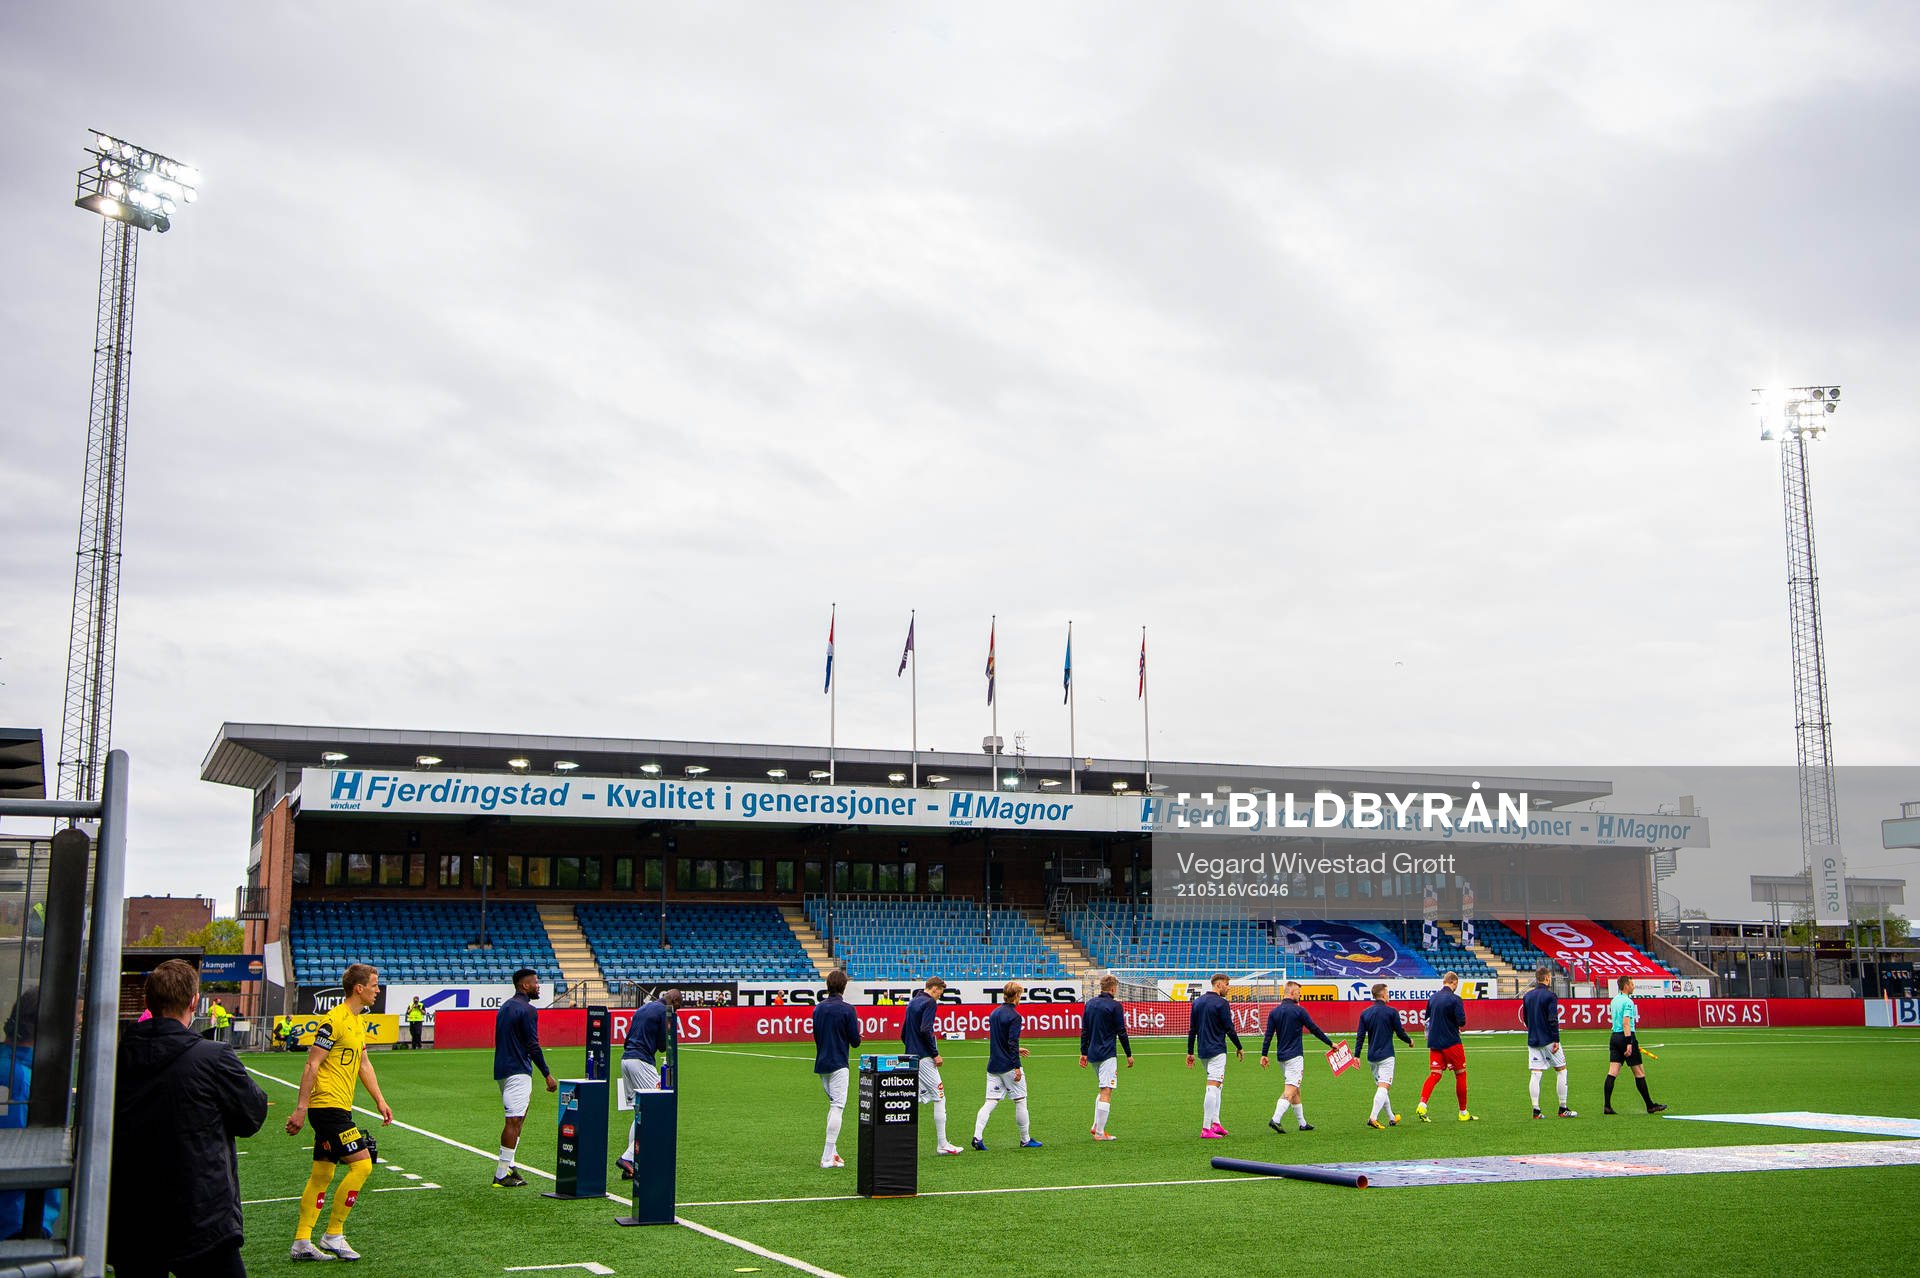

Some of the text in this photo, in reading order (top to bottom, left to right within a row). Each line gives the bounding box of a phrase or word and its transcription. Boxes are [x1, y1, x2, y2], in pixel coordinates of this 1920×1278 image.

[330, 801, 361, 810] vinduet
[366, 776, 569, 811] Fjerdingstad
[607, 783, 715, 809] Kvalitet
[725, 785, 732, 811] i
[742, 789, 916, 820] generasjoner
[975, 796, 1073, 825] Magnor
[1616, 818, 1691, 843] Magnor
[1556, 950, 1641, 966] SKILT
[1579, 966, 1654, 974] DESIGN
[739, 989, 829, 1006] TES
[983, 988, 1076, 1004] TSS
[757, 1015, 888, 1034] entrenør
[1125, 1008, 1166, 1028] tleie
[1571, 1004, 1592, 1023] 75
[1705, 1004, 1762, 1023] RVS AS
[881, 1076, 914, 1087] altibox
[884, 1100, 911, 1110] coop
[885, 1113, 910, 1122] SELECT
[346, 1141, 358, 1152] 10
